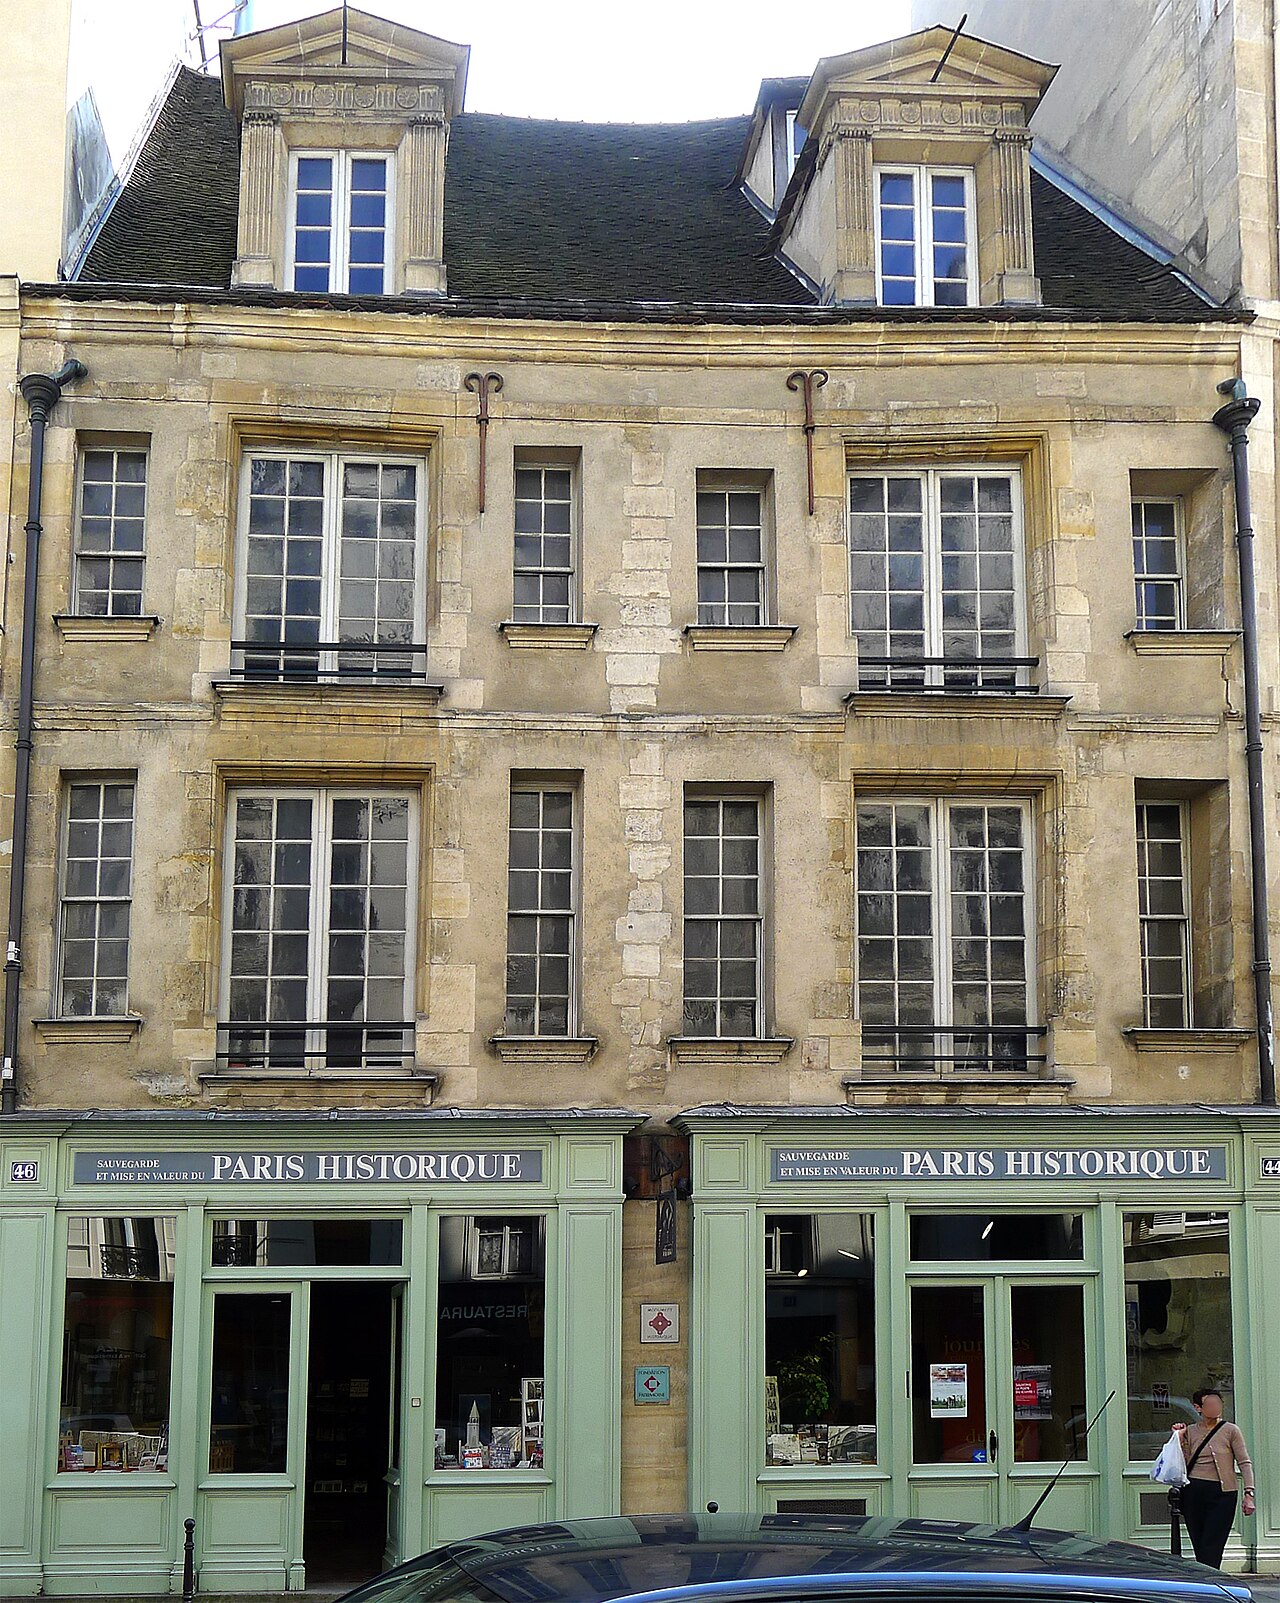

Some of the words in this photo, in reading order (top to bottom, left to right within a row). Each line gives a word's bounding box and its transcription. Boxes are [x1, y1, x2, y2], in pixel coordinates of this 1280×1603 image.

[779, 1151, 850, 1162] SAUVEGARDE
[97, 1159, 160, 1169] SAUVEGARDE
[211, 1155, 305, 1180] PARIS
[315, 1153, 522, 1182] HISTORIQUE
[900, 1150, 995, 1176] PARIS
[1004, 1149, 1211, 1179] HISTORIQUE
[13, 1163, 35, 1180] 46
[96, 1172, 109, 1181] ET
[110, 1172, 136, 1181] MISE
[137, 1172, 150, 1181] EN
[152, 1171, 189, 1181] VALEUR
[191, 1171, 205, 1181] DU
[780, 1167, 794, 1176] ET
[795, 1167, 821, 1176] MISE
[823, 1167, 838, 1176] EN
[839, 1166, 881, 1176] VALEUR
[882, 1166, 898, 1175] DU
